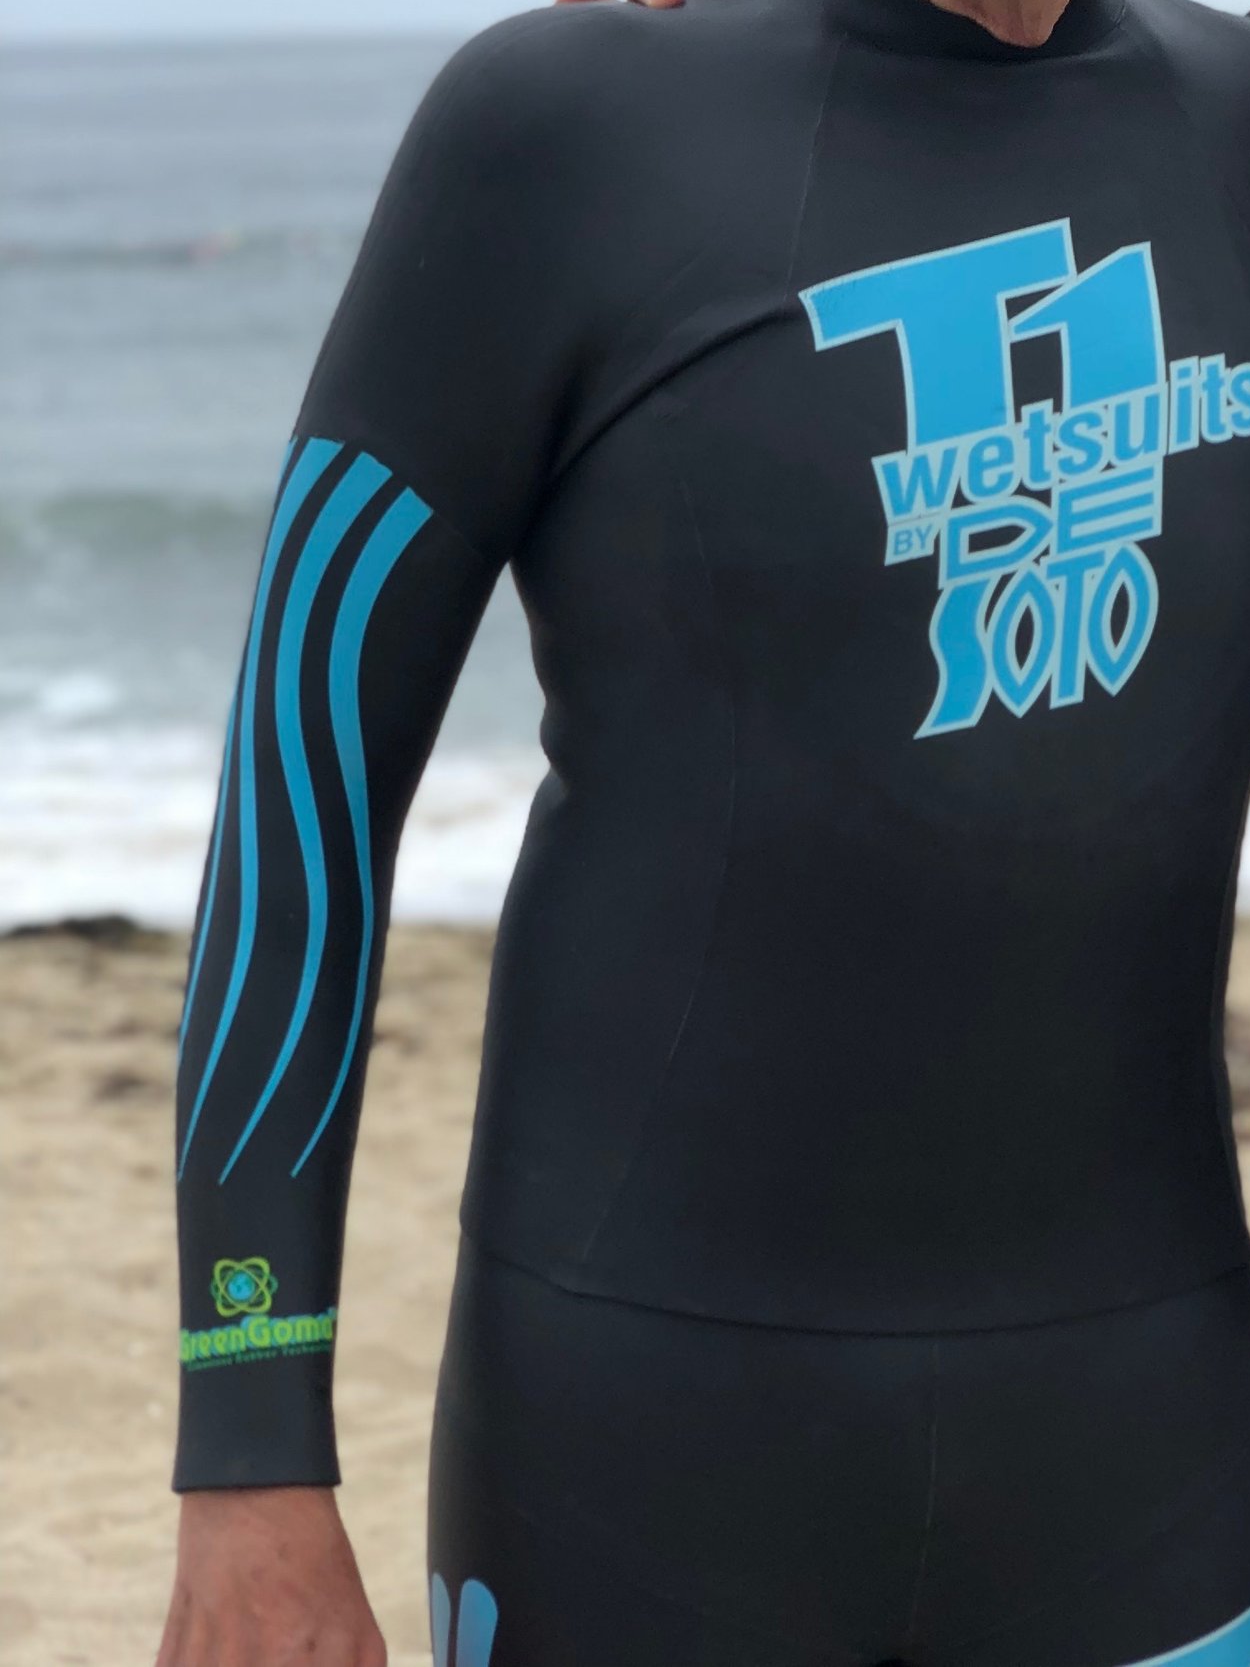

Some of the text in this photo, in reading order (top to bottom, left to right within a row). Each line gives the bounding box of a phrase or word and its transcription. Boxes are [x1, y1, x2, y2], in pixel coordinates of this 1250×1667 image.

[798, 218, 1166, 452] T1
[888, 458, 1162, 589] BY DE
[914, 541, 1159, 739] SOTO
